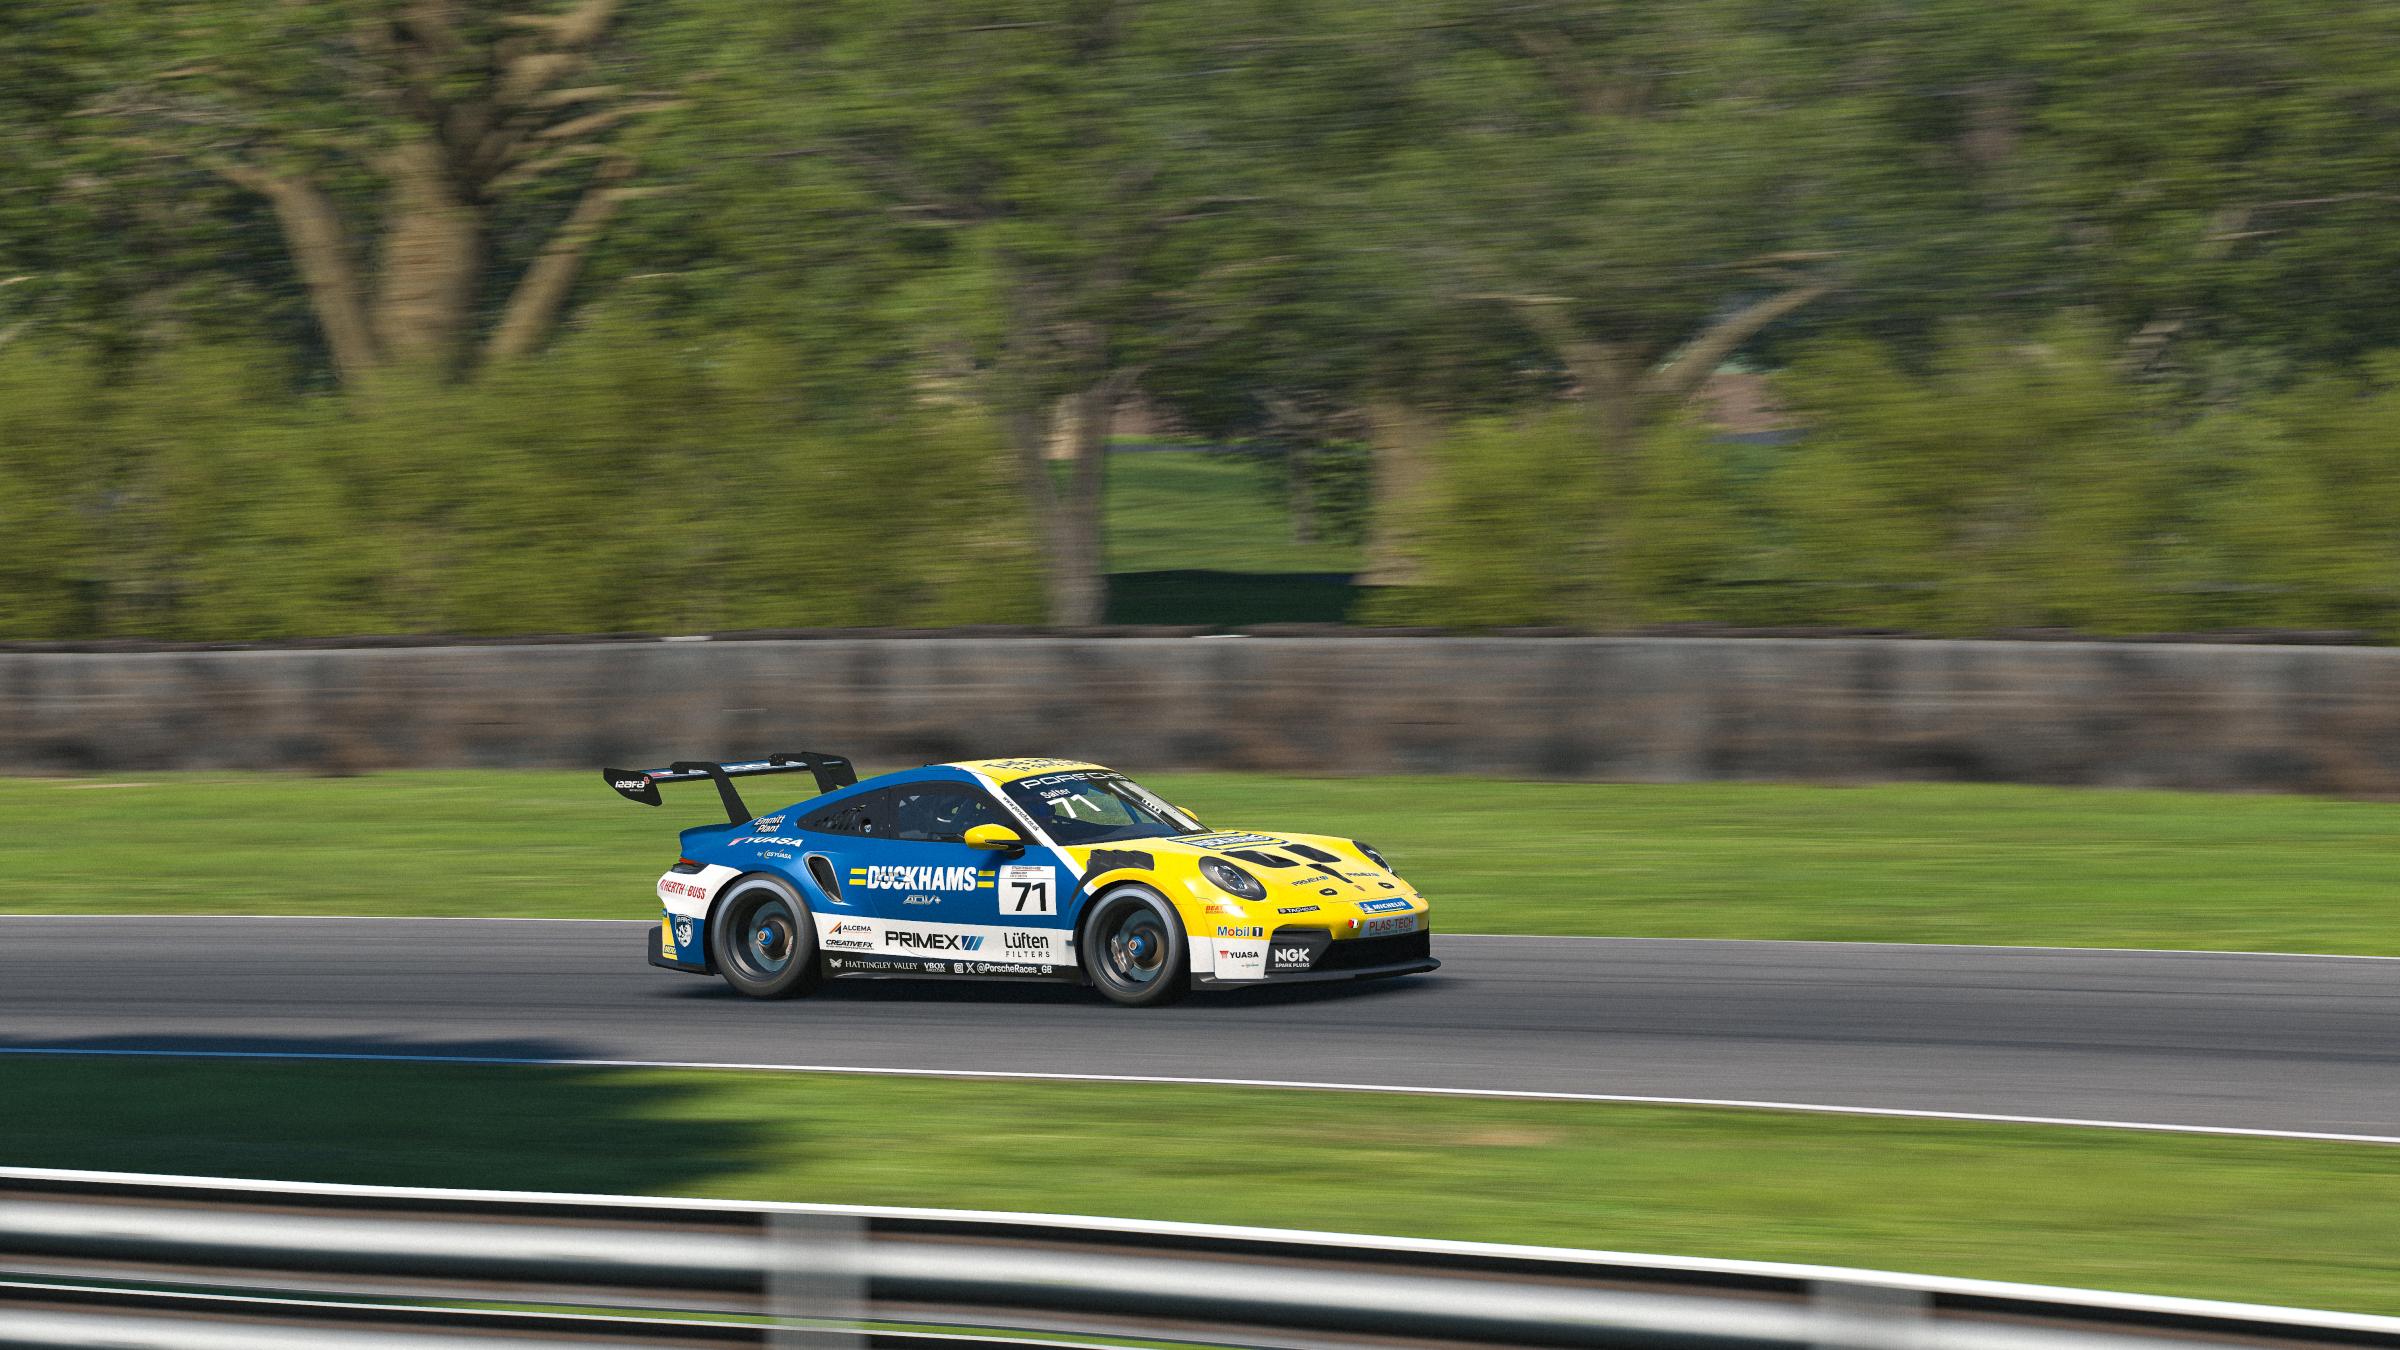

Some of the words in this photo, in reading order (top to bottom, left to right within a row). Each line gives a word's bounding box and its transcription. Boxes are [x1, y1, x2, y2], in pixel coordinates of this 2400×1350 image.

[1040, 788, 1071, 799] Salter
[1046, 794, 1102, 818] 71
[745, 836, 803, 847] YUASA
[867, 865, 977, 892] DUCKHAMS
[1011, 881, 1047, 911] 71
[1372, 901, 1407, 910] MICHELIN
[843, 924, 872, 932] ALCEMA
[1217, 926, 1250, 937] Mobil
[885, 930, 960, 950] PRIMEX
[1004, 932, 1049, 949] Lüften
[1230, 951, 1259, 959] YUASA
[1274, 947, 1310, 962] NGK
[845, 961, 891, 970] HATTINGLEY
[893, 962, 918, 970] VALLEY
[976, 962, 1053, 975] @PorscheRaces_GB
